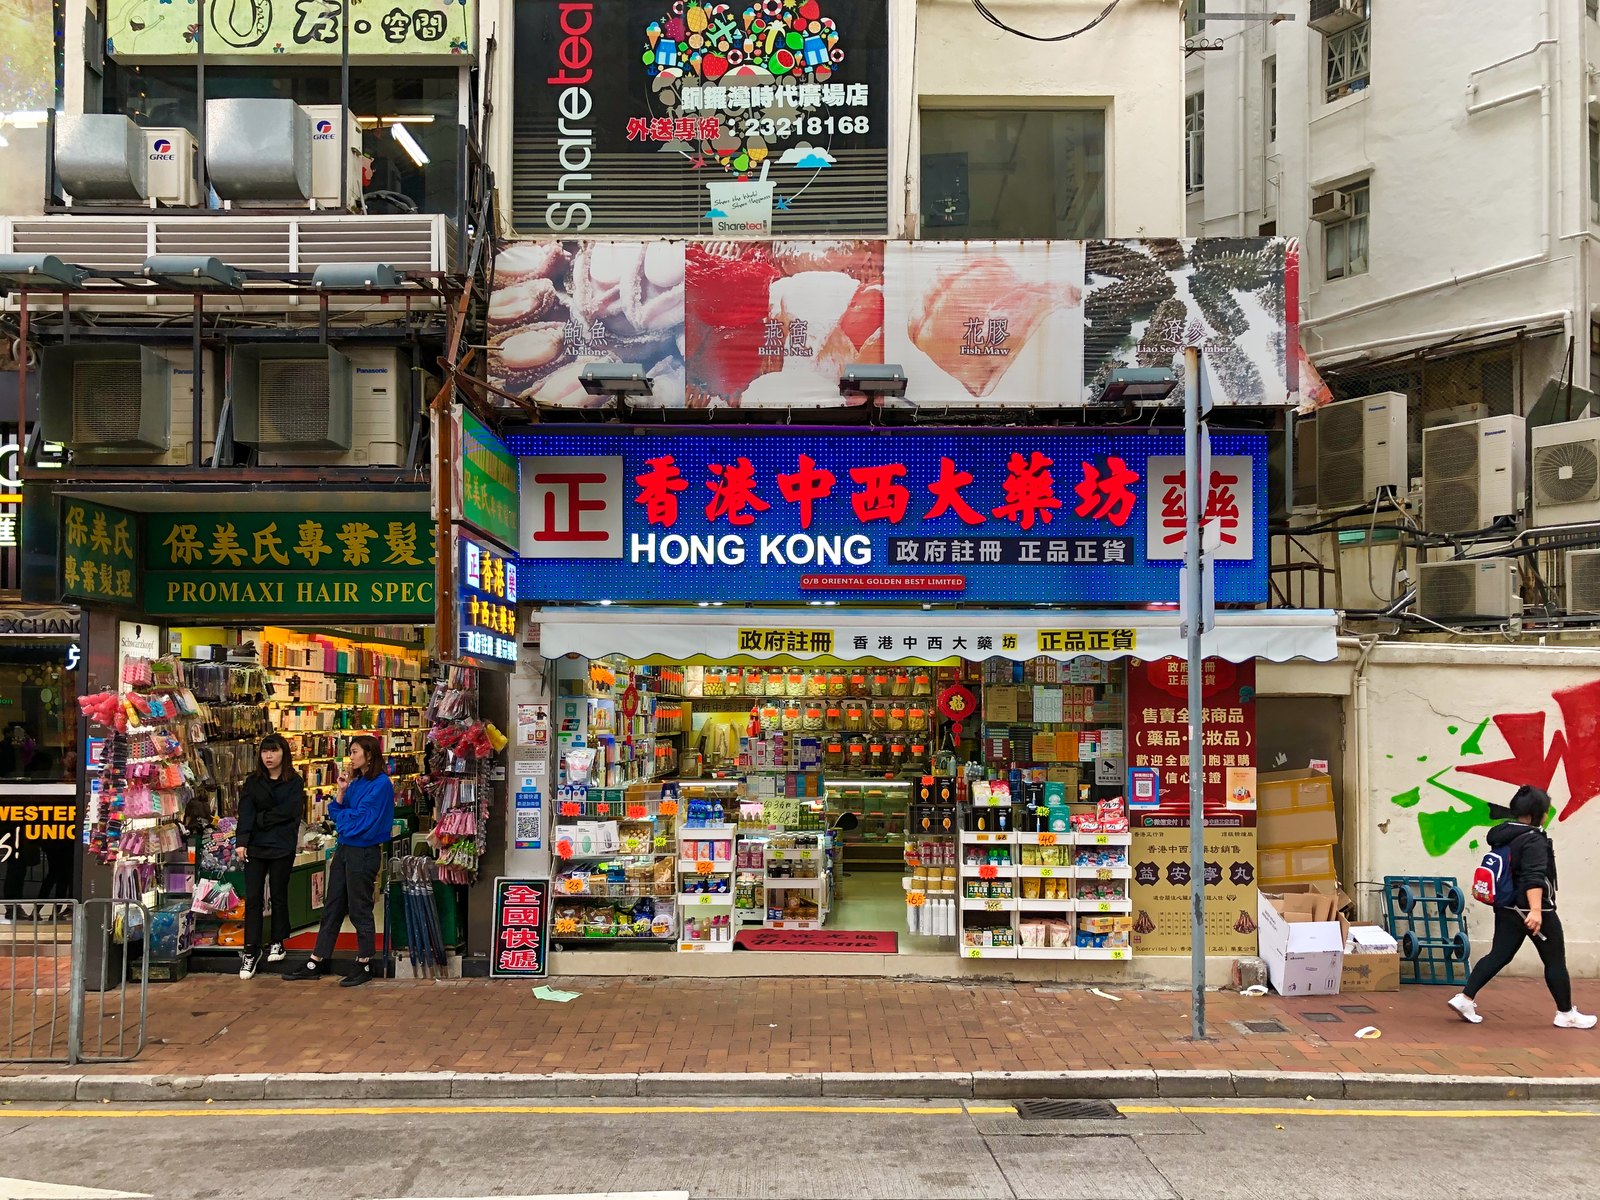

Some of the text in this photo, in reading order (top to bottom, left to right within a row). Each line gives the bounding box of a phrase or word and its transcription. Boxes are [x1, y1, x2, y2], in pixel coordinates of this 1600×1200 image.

[680, 83, 869, 110] 銅鑼灣時代廣場店
[545, 3, 593, 231] Sharetea
[744, 116, 870, 136] 23218168
[718, 221, 762, 231] Sharetea
[563, 319, 608, 346] 鮑魚
[764, 319, 809, 347] 燕窩
[963, 318, 1010, 346] 花膠
[564, 347, 608, 356] Abalone
[758, 347, 813, 356] Bird's Nest
[960, 346, 1010, 355] Fish Maw
[1136, 344, 1231, 354] Liao Sea Cmber
[533, 473, 609, 542] 正
[634, 452, 1140, 529] 香港中西大藥坊
[66, 506, 133, 559] 保美氏
[631, 534, 871, 565] HONG KONG
[895, 538, 1128, 563] 政府註冊 正品正貨
[482, 551, 505, 598] 香港
[803, 578, 962, 586] O/B ORIENTAL GOLDEN BEST LIMITED
[167, 582, 434, 603] PROMAXI HAIR SPEC
[739, 629, 1134, 654] 政府註冊 香港中西大藥坊 正品正貨
[1167, 661, 1216, 673] 政府冊
[1167, 674, 1216, 686] 正品貨
[1041, 835, 1054, 845] 40
[1147, 845, 1241, 854] 香港中西坊銷售
[499, 885, 541, 970] 全國快遞
